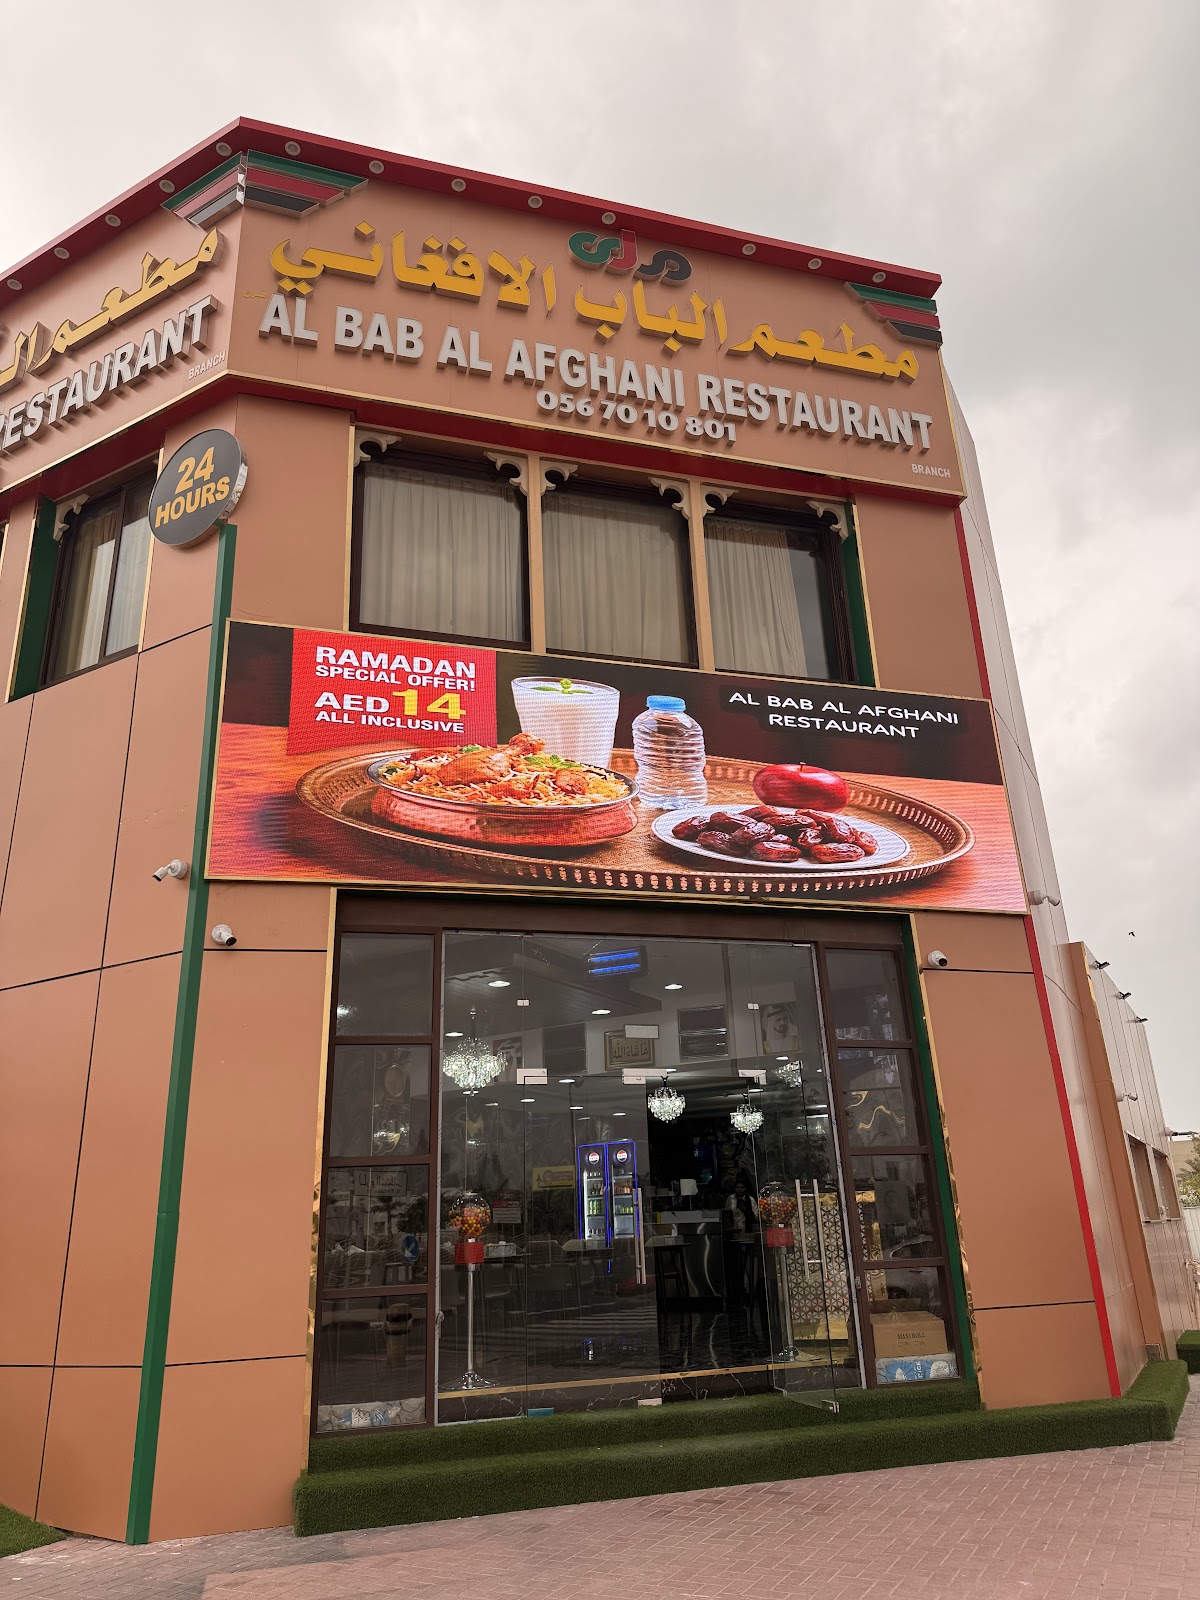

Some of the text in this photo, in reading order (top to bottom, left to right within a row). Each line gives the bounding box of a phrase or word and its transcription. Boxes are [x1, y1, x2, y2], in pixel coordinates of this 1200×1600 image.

[27, 227, 219, 374] مطعم
[574, 280, 728, 355] الباب
[188, 350, 227, 380] BRANCH
[727, 320, 920, 383] مطعم
[259, 293, 933, 450] AL BAB AL AFGHANI RESTAURANT
[536, 388, 737, 443] 056 70 10 801
[174, 446, 215, 495] 24
[911, 463, 951, 479] BRANCH
[154, 476, 231, 529] HOURS
[315, 646, 476, 678] RAMADAN
[315, 665, 476, 692] SPECIAL OFFER!
[314, 688, 467, 720] AED 14
[728, 691, 960, 725] AL BAB AL AFGHANI
[315, 710, 465, 734] ALL INCLUSIVE
[768, 713, 920, 739] RESTAURANT
